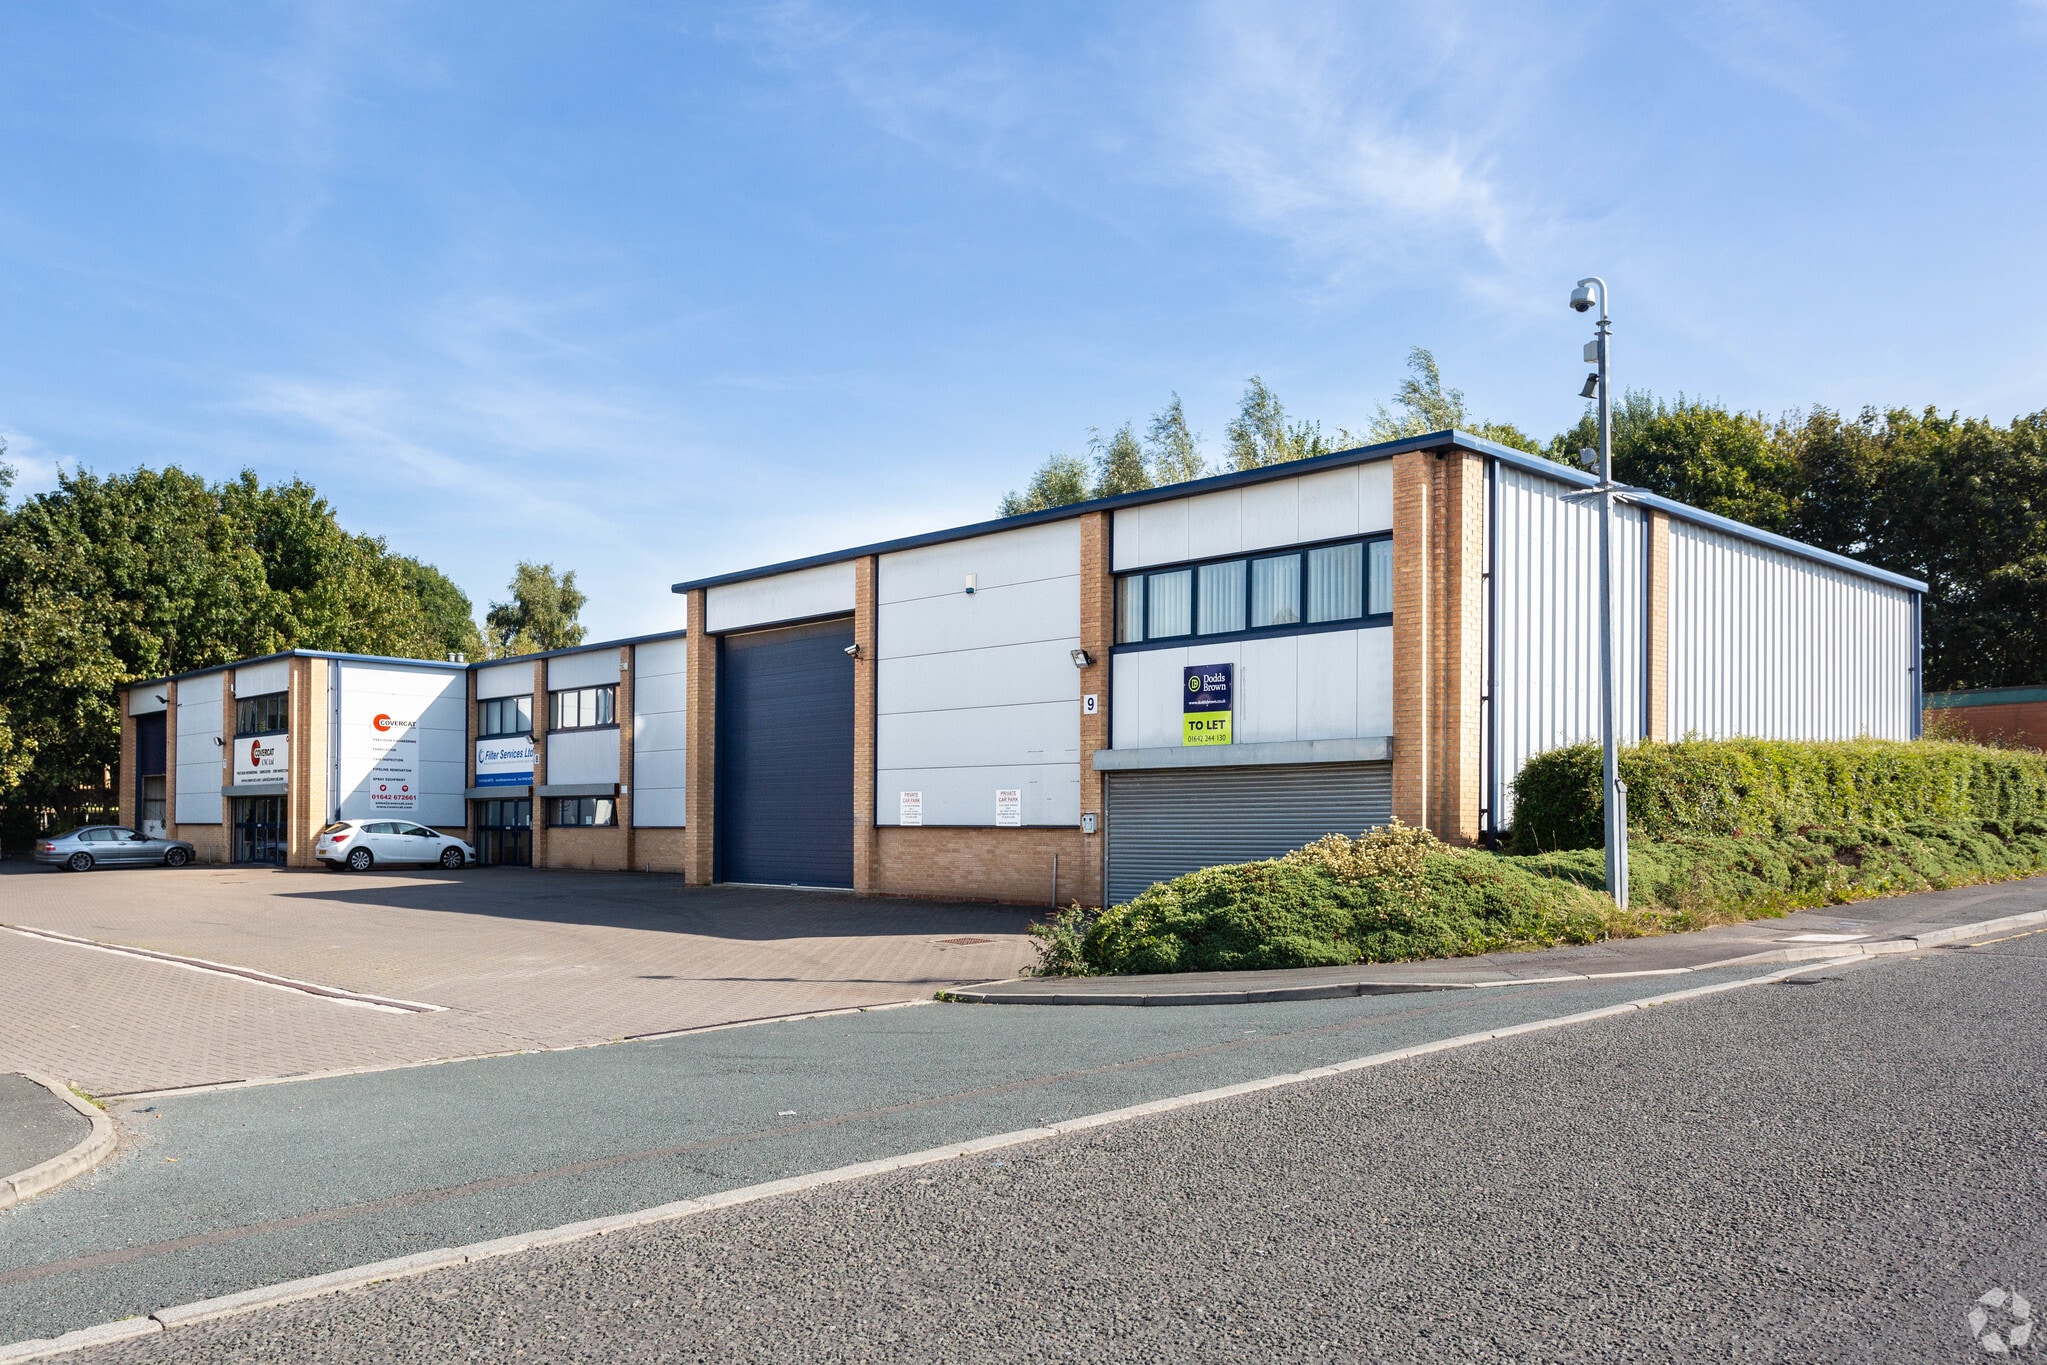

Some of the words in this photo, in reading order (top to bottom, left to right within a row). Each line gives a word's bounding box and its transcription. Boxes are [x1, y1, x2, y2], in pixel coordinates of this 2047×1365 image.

[1203, 673, 1225, 682] Dodds
[1203, 683, 1226, 692] Brown
[1087, 697, 1094, 710] 9
[1188, 720, 1204, 730] TO
[1206, 720, 1226, 730] LET
[255, 748, 274, 757] COVERCAT
[485, 750, 499, 760] Filter
[500, 749, 523, 759] Services
[524, 748, 534, 758] Ltd
